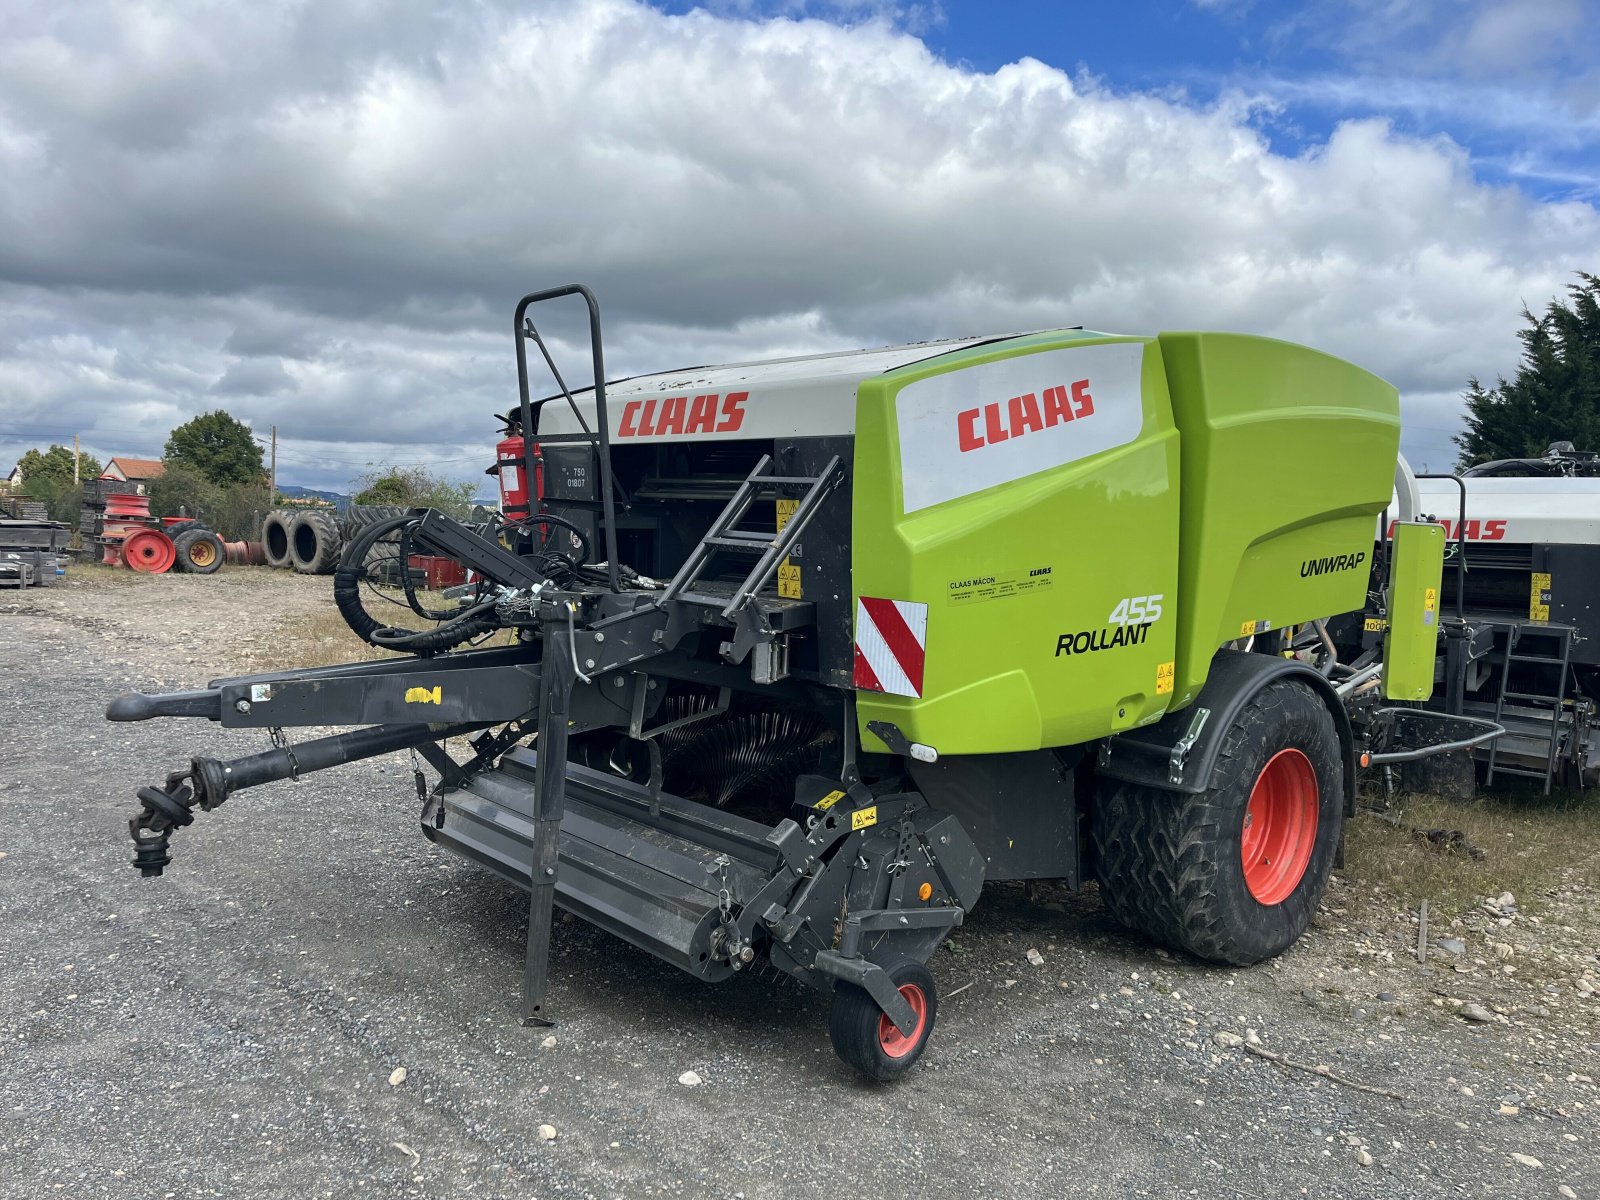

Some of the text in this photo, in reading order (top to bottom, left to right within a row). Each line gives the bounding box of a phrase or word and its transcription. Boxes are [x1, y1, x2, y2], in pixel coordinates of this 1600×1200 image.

[618, 391, 749, 437] CLAAS
[958, 379, 1095, 453] CLAAS
[1029, 566, 1052, 577] CLAAS
[1300, 551, 1366, 578] UNIWRAP
[950, 580, 972, 590] CLAAS
[1108, 593, 1164, 627] 455
[1054, 621, 1153, 657] ROLLANT
